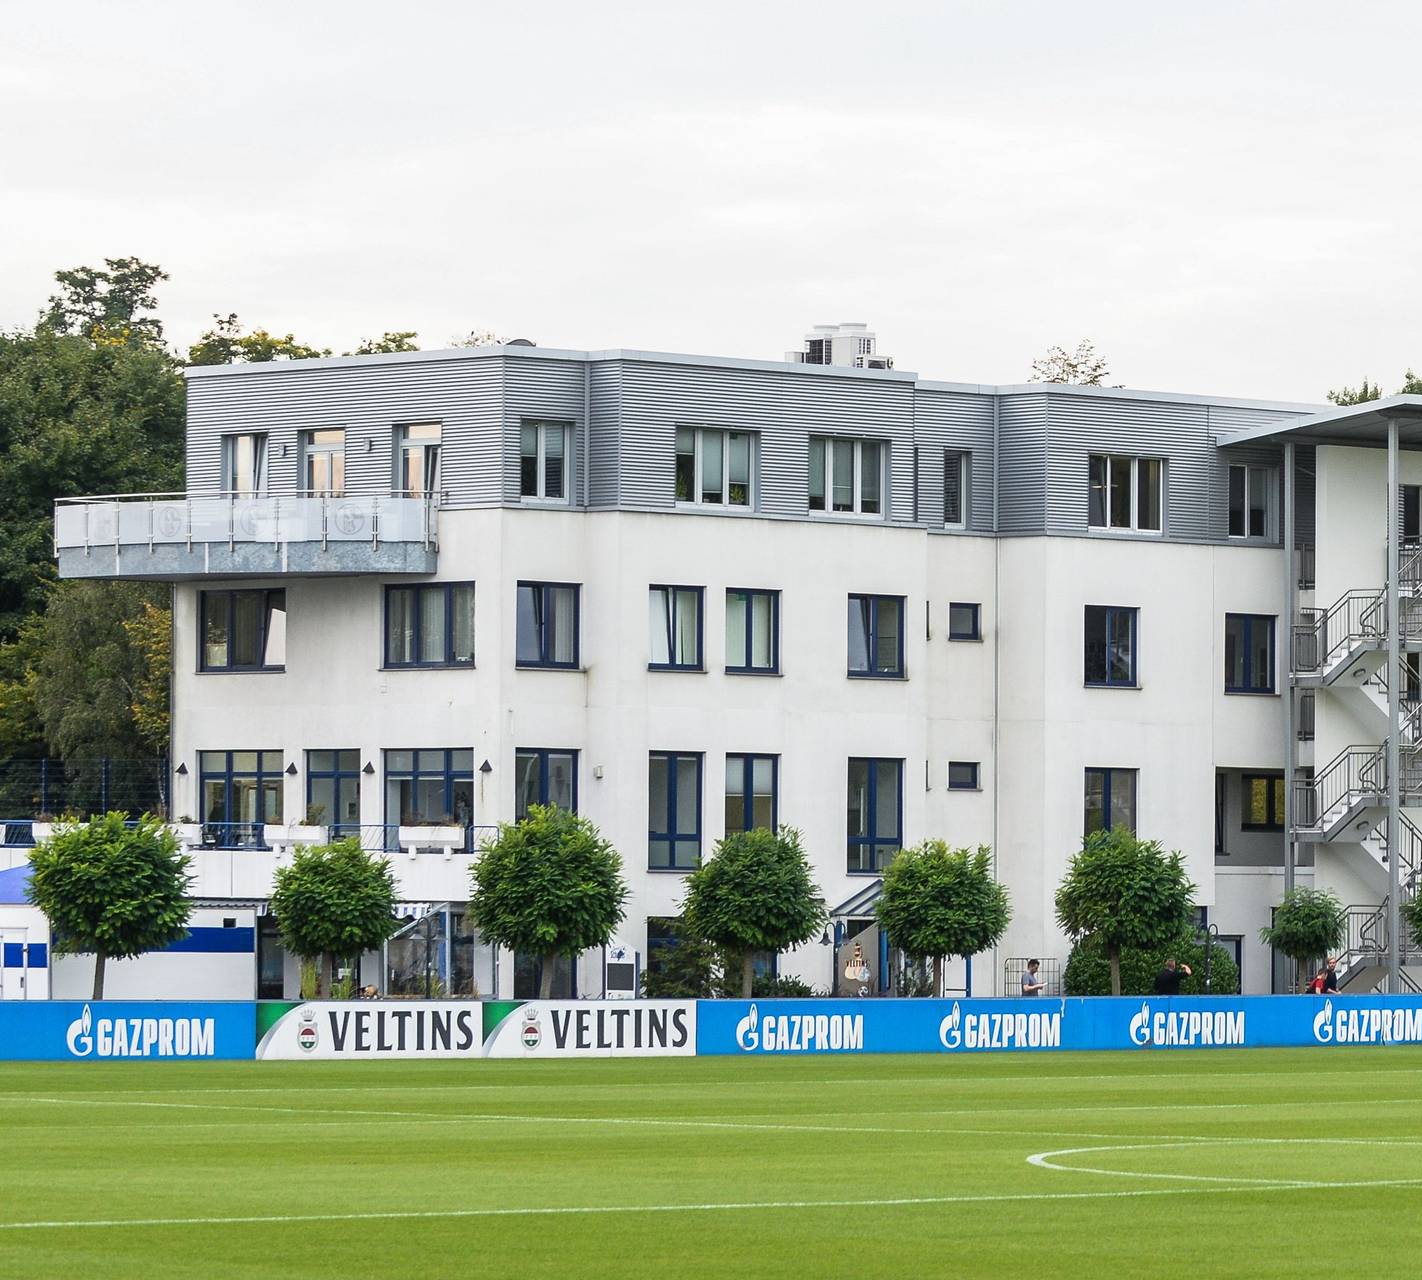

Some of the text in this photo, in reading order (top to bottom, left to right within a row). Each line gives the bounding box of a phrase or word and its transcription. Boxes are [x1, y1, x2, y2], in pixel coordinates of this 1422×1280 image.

[98, 1018, 215, 1056] GAZPROM
[328, 1010, 473, 1052] VELTINS
[550, 1008, 688, 1049] VELTINS
[762, 1014, 864, 1051] GAZPROM
[964, 1013, 1061, 1048] GAZPROM
[1153, 1011, 1245, 1045] GAZPROM
[1336, 1008, 1422, 1043] GAZPROM
